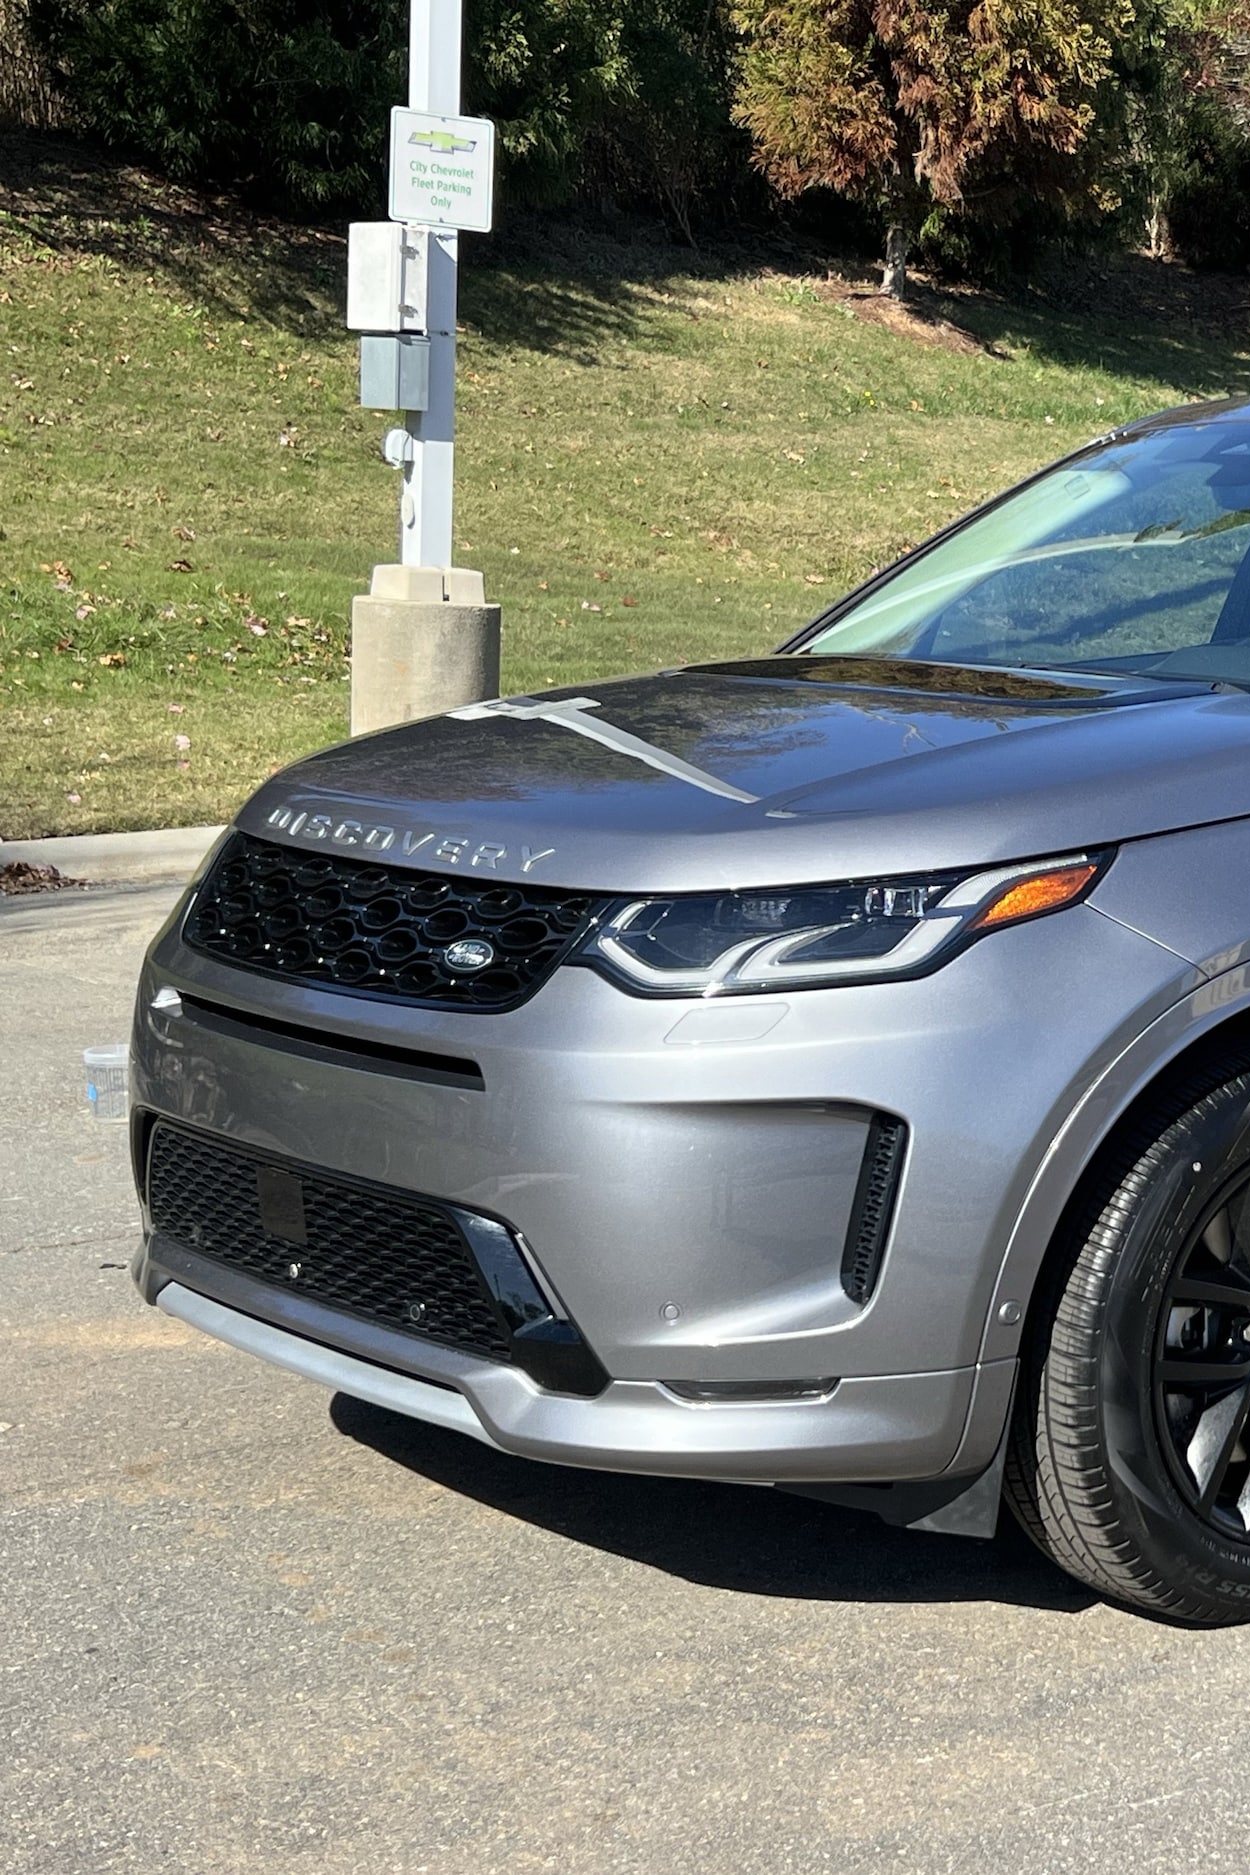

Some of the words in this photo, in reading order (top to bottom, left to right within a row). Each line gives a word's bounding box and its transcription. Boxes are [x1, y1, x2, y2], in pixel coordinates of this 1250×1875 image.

[410, 160, 428, 174] City
[430, 163, 474, 179] Chevrolet
[411, 177, 434, 190] Fleet
[437, 180, 472, 196] Parking
[430, 196, 451, 209] Only
[268, 805, 556, 873] DISCOVERY
